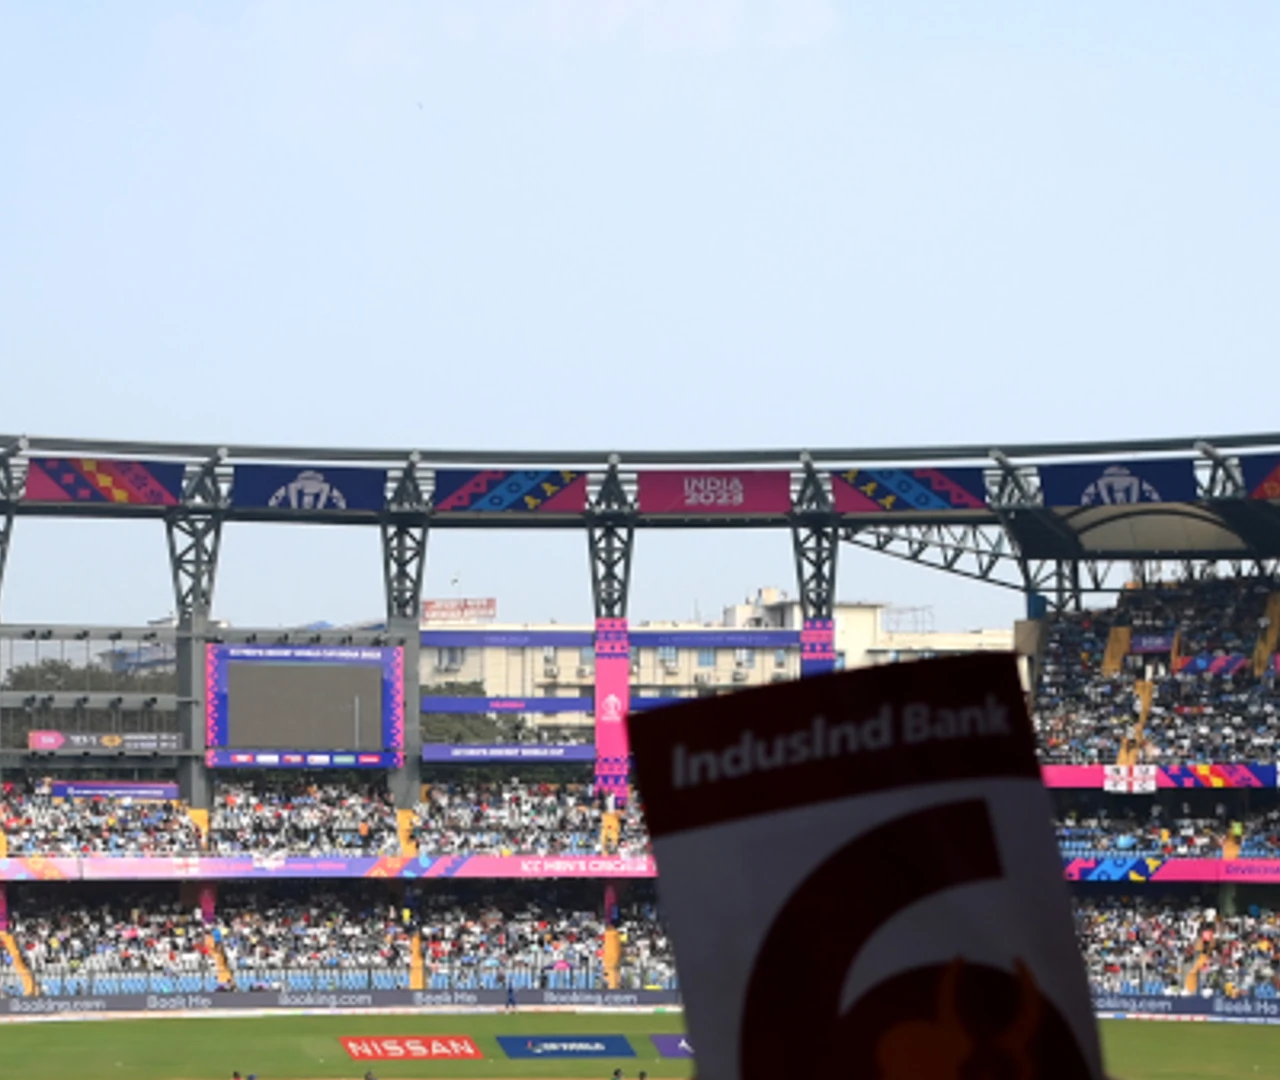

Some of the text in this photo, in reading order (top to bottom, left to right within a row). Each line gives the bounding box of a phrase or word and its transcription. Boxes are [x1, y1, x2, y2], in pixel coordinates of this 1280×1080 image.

[684, 476, 744, 491] INDIA
[673, 696, 1012, 789] IndusInd Bank
[347, 1039, 475, 1057] NISSAN
